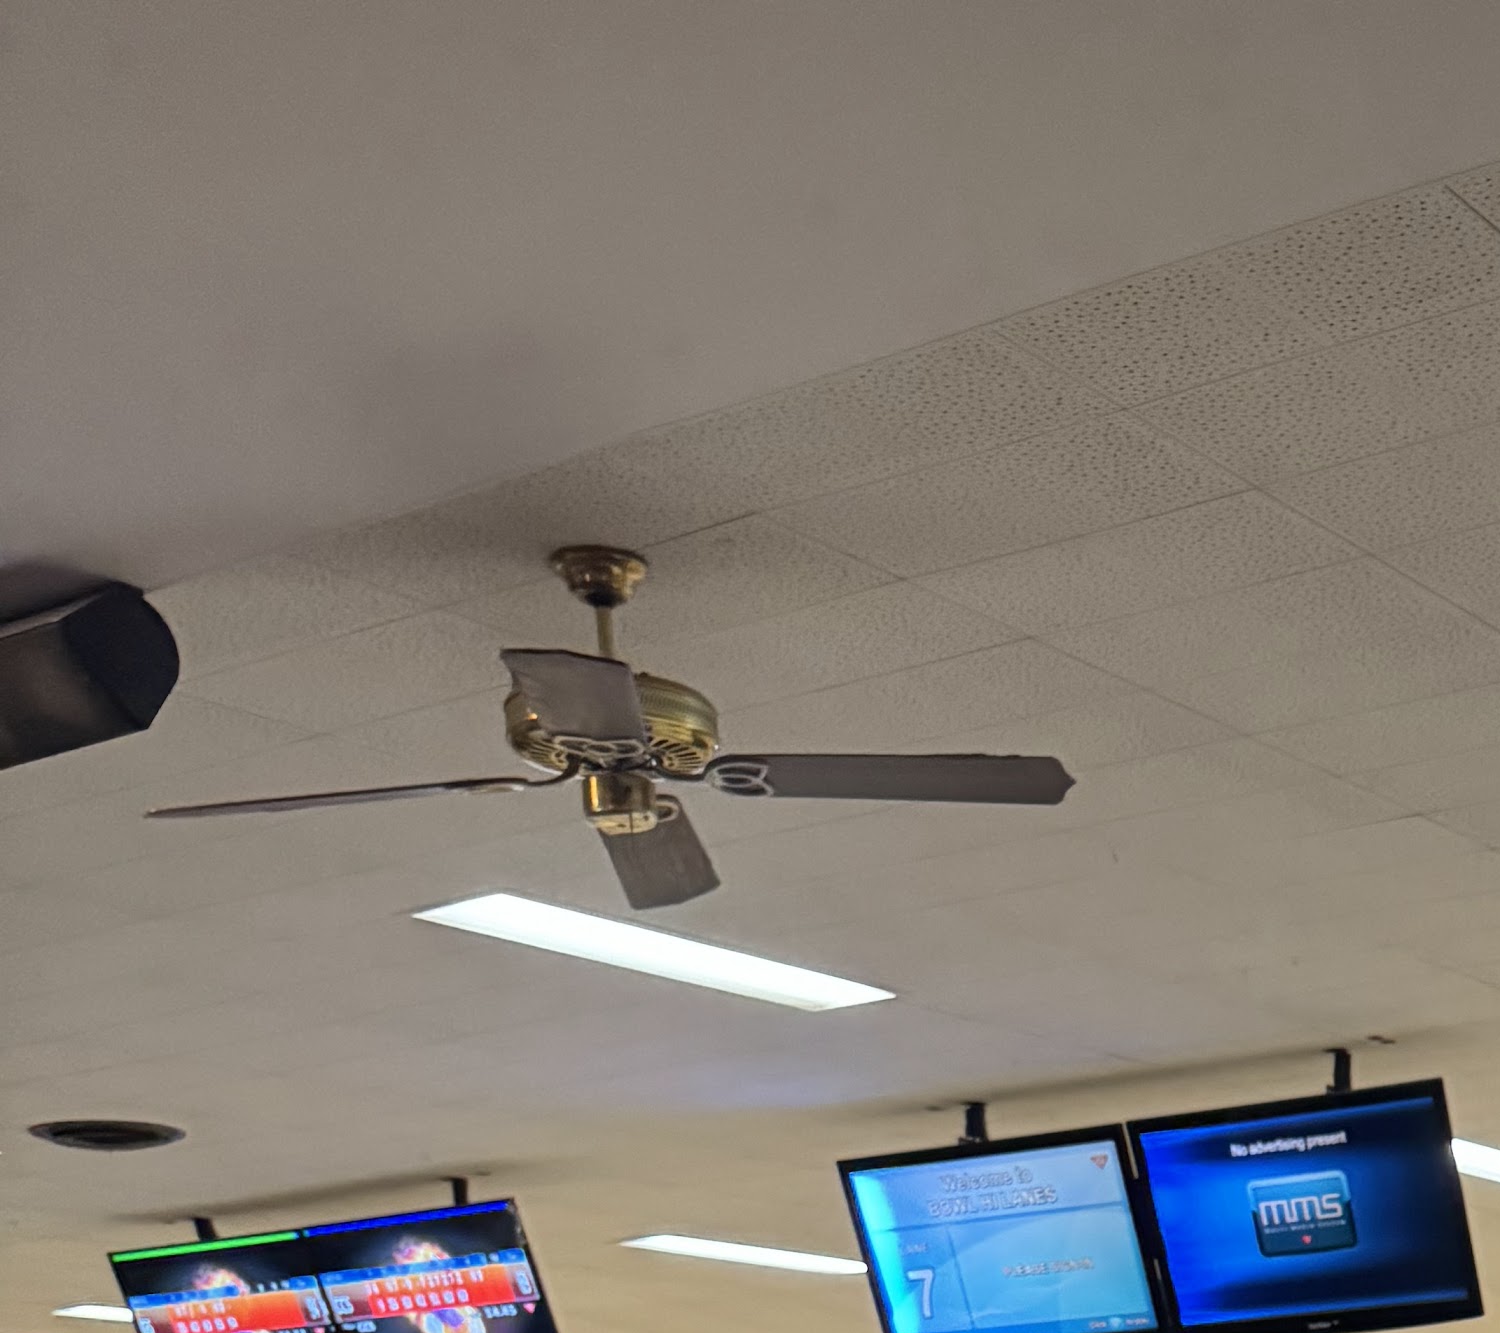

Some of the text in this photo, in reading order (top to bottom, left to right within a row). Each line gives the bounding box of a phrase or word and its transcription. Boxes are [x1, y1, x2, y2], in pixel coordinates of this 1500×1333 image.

[939, 1170, 1013, 1192] Welcome
[927, 1196, 978, 1217] BOWL
[906, 1266, 936, 1320] 7
